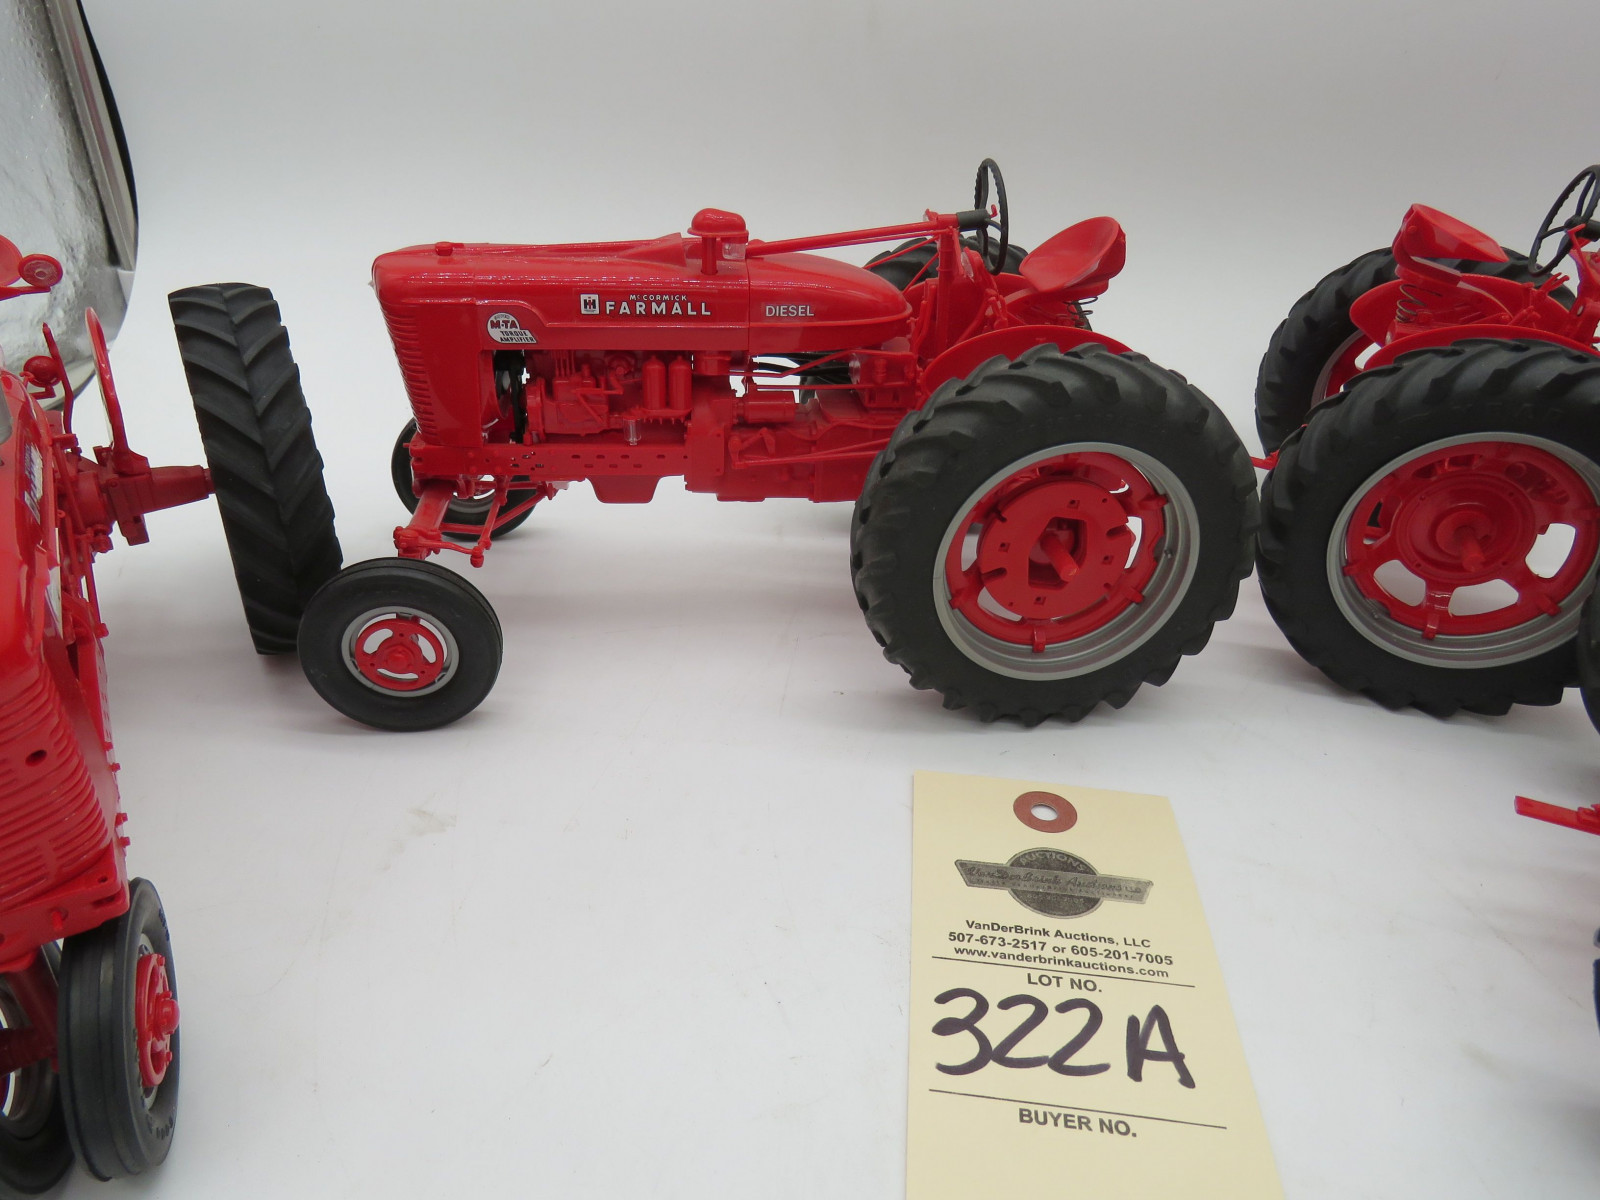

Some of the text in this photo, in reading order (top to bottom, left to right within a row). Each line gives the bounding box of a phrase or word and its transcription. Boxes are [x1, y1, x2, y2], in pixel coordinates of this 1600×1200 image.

[605, 301, 711, 316] FARMALL
[765, 304, 815, 317] DIESEL
[1019, 851, 1088, 872] AUCTIONS
[948, 931, 1173, 965] 507-673-2517 or 605-201-7005
[966, 920, 1150, 948] VanDerBrink Auctions, LLC
[954, 947, 1169, 978] www.vanderbrinkauctions.com
[1027, 972, 1103, 993] LOT NO.
[932, 987, 1196, 1089] 322A
[1019, 1108, 1137, 1138] BUYER NO.
